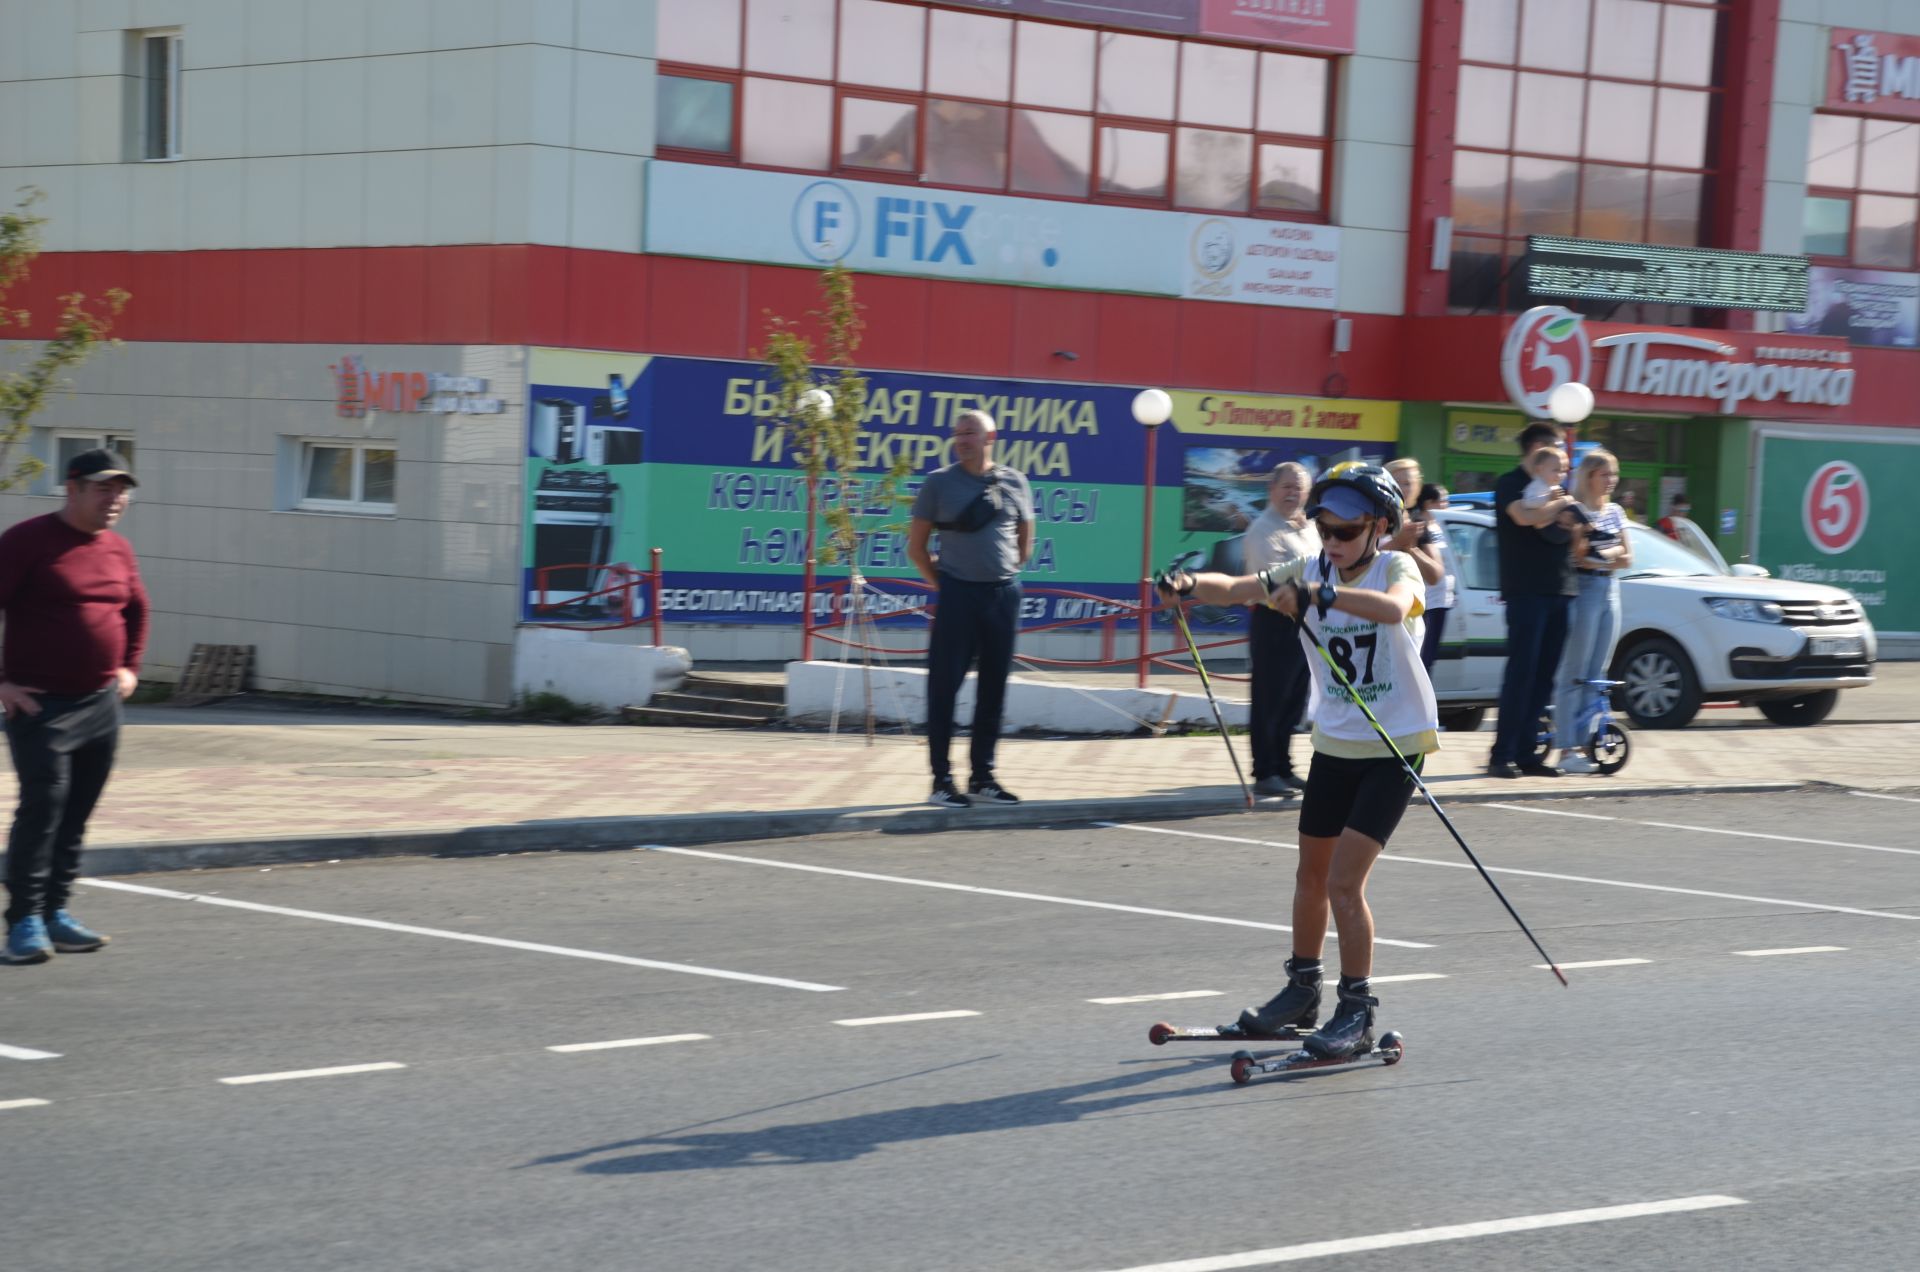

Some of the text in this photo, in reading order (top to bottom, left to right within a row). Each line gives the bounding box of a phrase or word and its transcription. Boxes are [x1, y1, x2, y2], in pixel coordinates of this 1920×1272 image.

[814, 201, 840, 243] F
[1523, 332, 1573, 406] 5
[723, 378, 1099, 435] БЫВАЯ ТЕХНИКА
[1302, 405, 1313, 428] 2
[751, 425, 1072, 477] И ЕКТРОИКА
[707, 472, 893, 516] КӨНКРЕШ
[1818, 476, 1853, 536] 5
[658, 588, 804, 613] БЕСПЛАТНАЯ
[1328, 632, 1377, 686] 87
